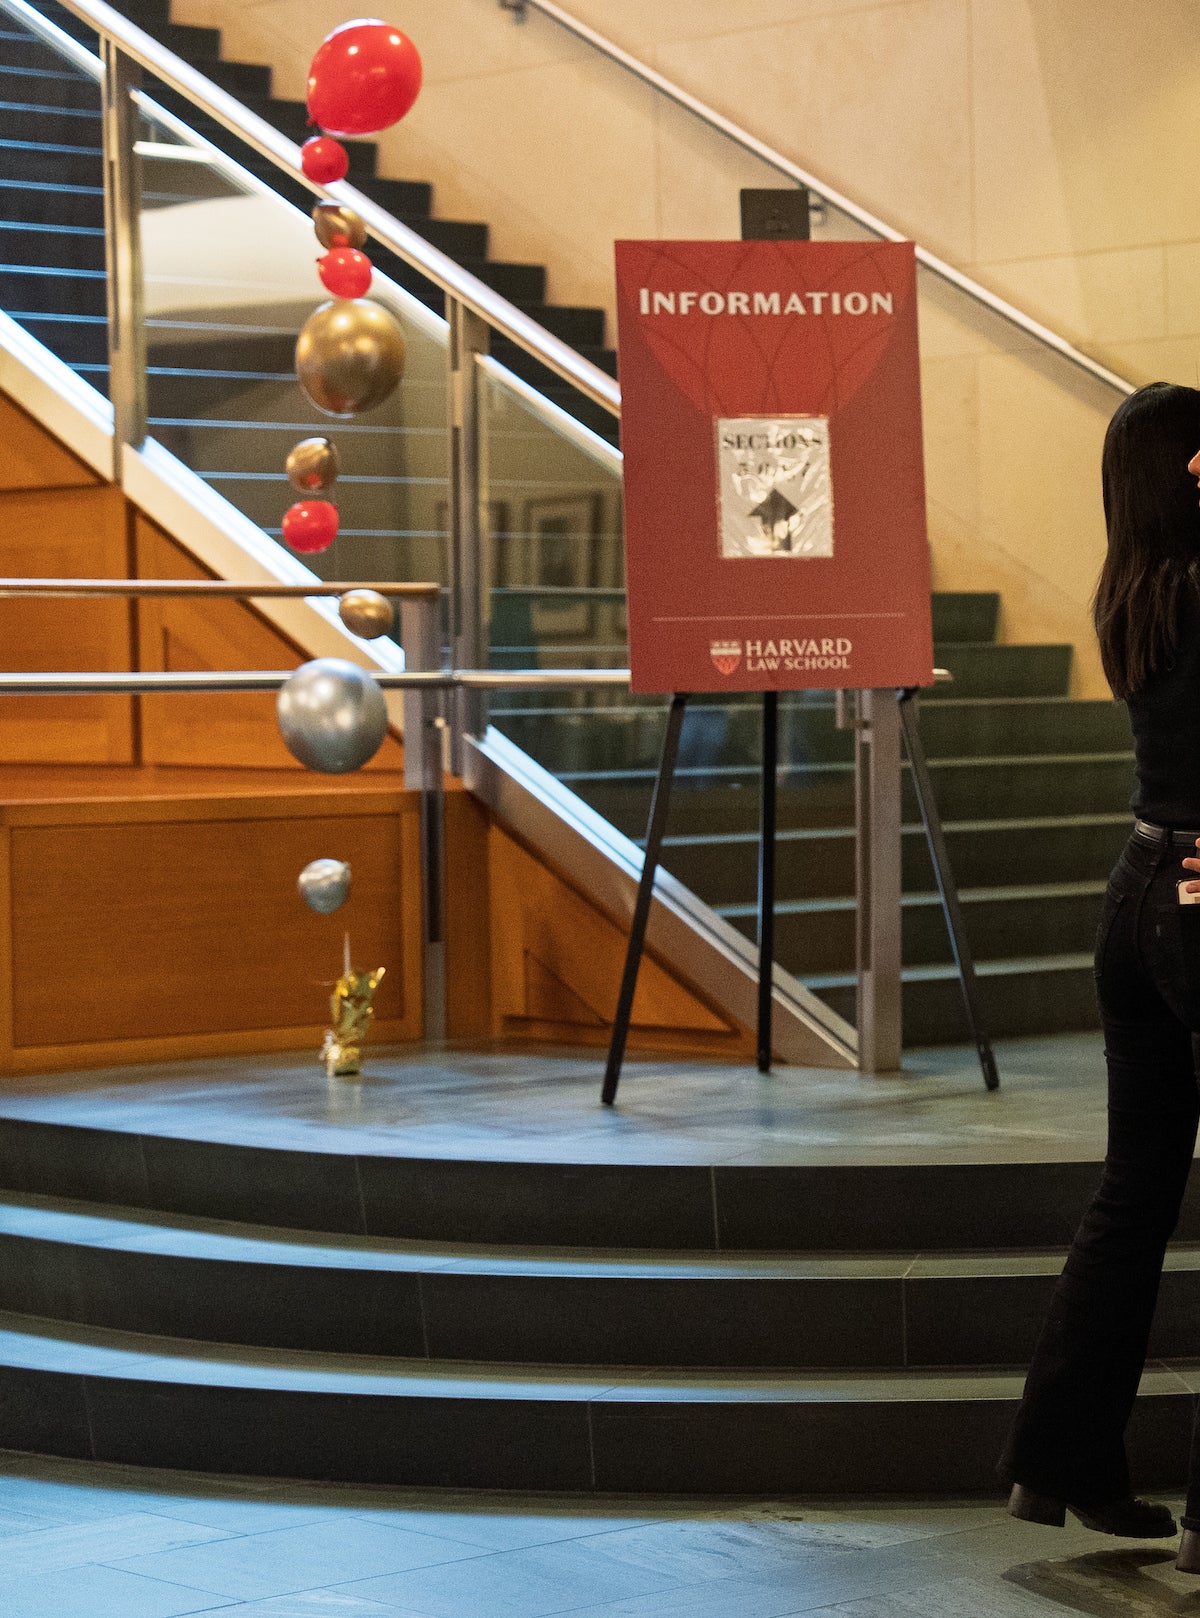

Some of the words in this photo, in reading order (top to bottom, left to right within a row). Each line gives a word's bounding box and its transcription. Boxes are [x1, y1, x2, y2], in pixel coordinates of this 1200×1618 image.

[639, 287, 894, 316] INFORMATION
[745, 637, 853, 657] HARVARD
[746, 657, 781, 672] LAW
[783, 656, 851, 671] SCHOOL
